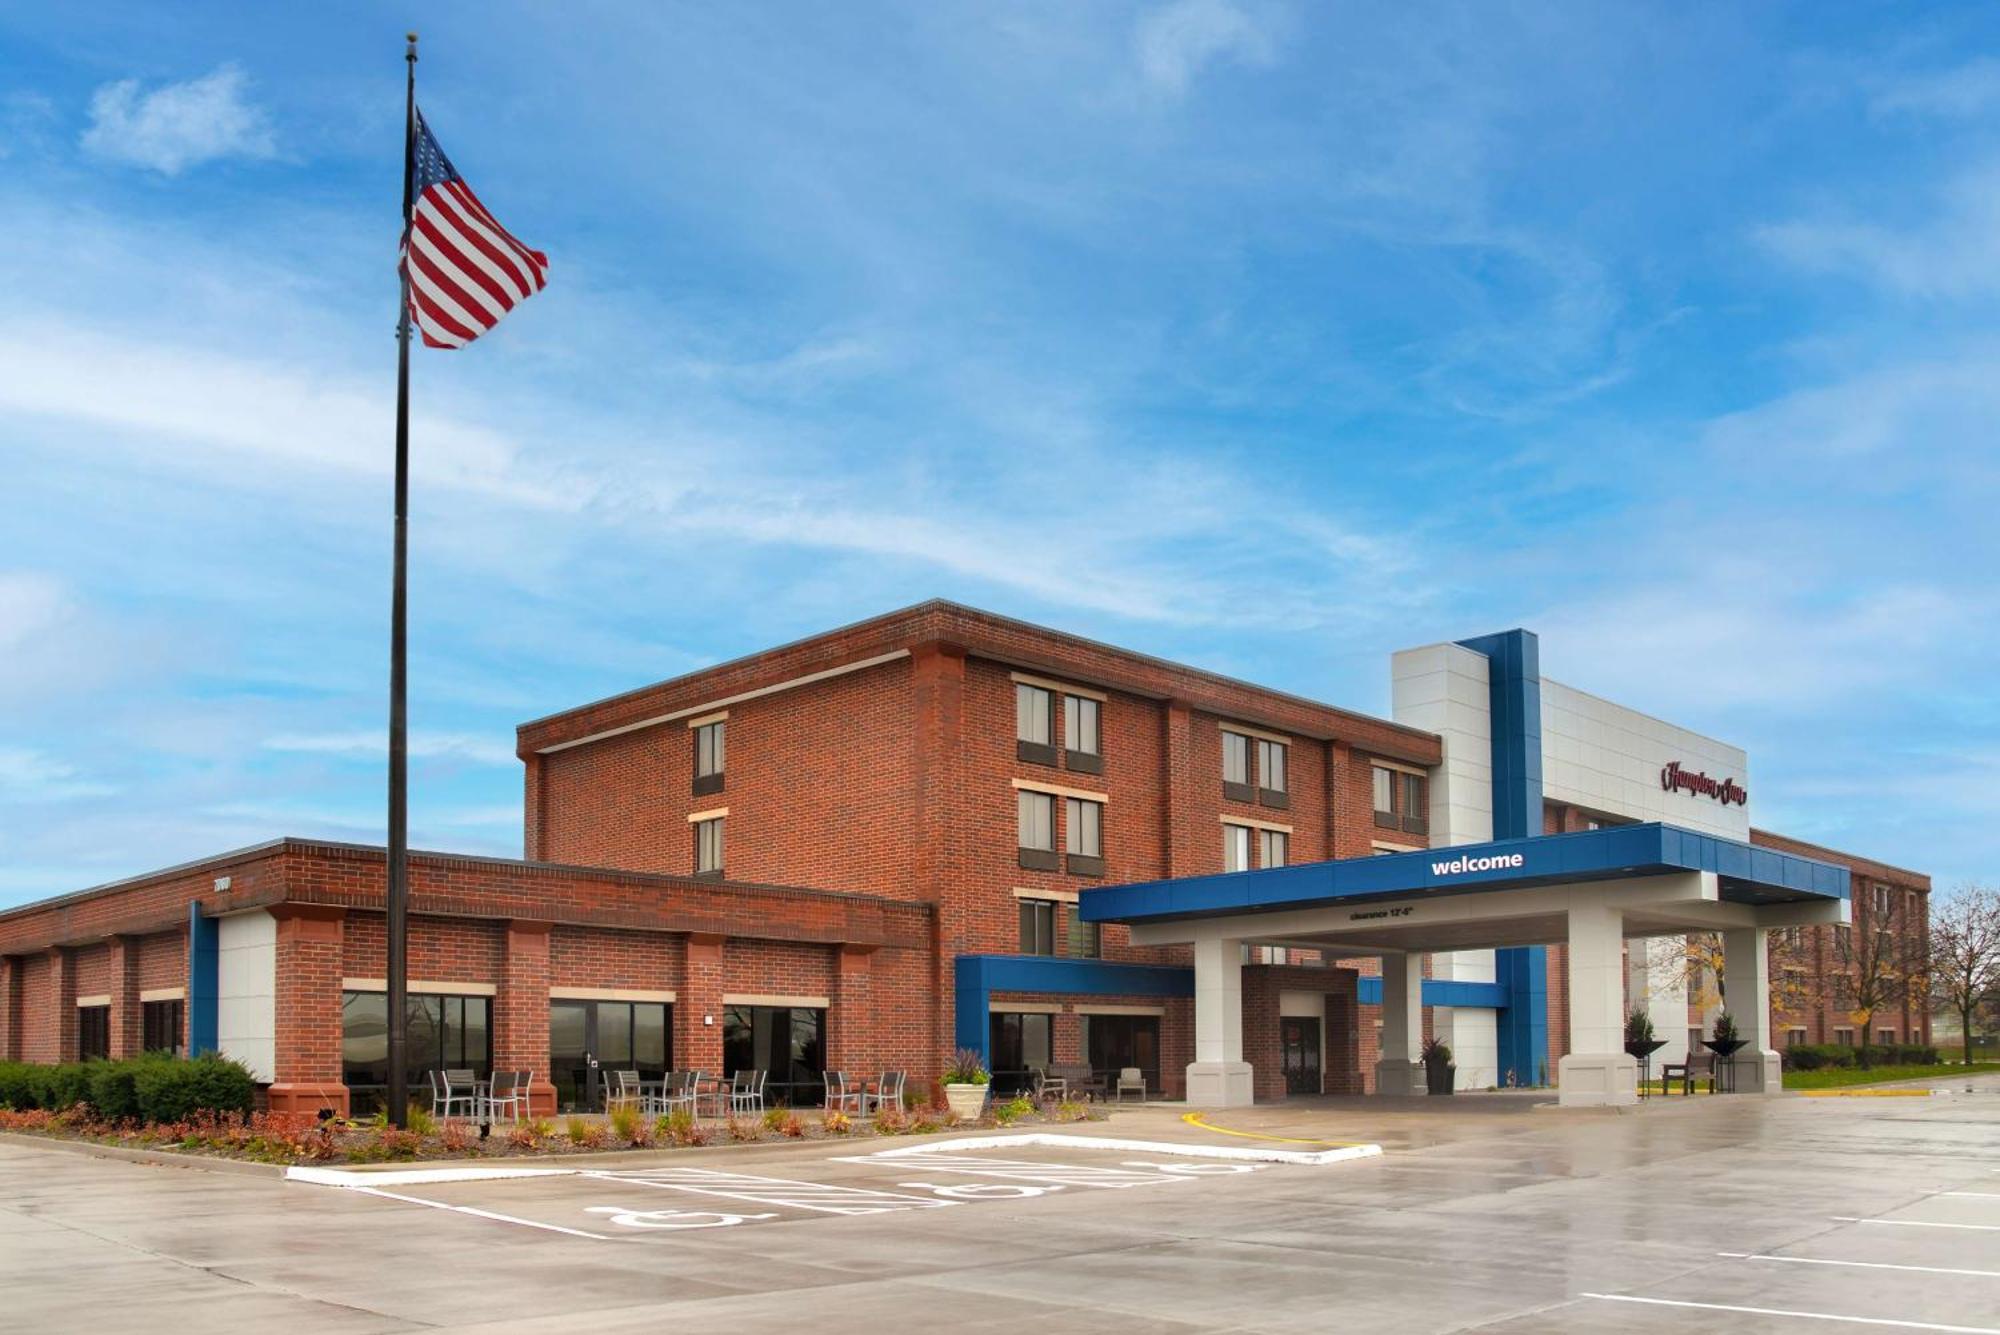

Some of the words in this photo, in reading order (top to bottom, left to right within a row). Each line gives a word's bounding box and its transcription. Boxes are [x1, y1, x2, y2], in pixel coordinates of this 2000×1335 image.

[1661, 761, 1720, 799] Hampton
[1720, 777, 1747, 806] Inn
[1431, 853, 1523, 876] welcome
[1350, 911, 1388, 921] clearance
